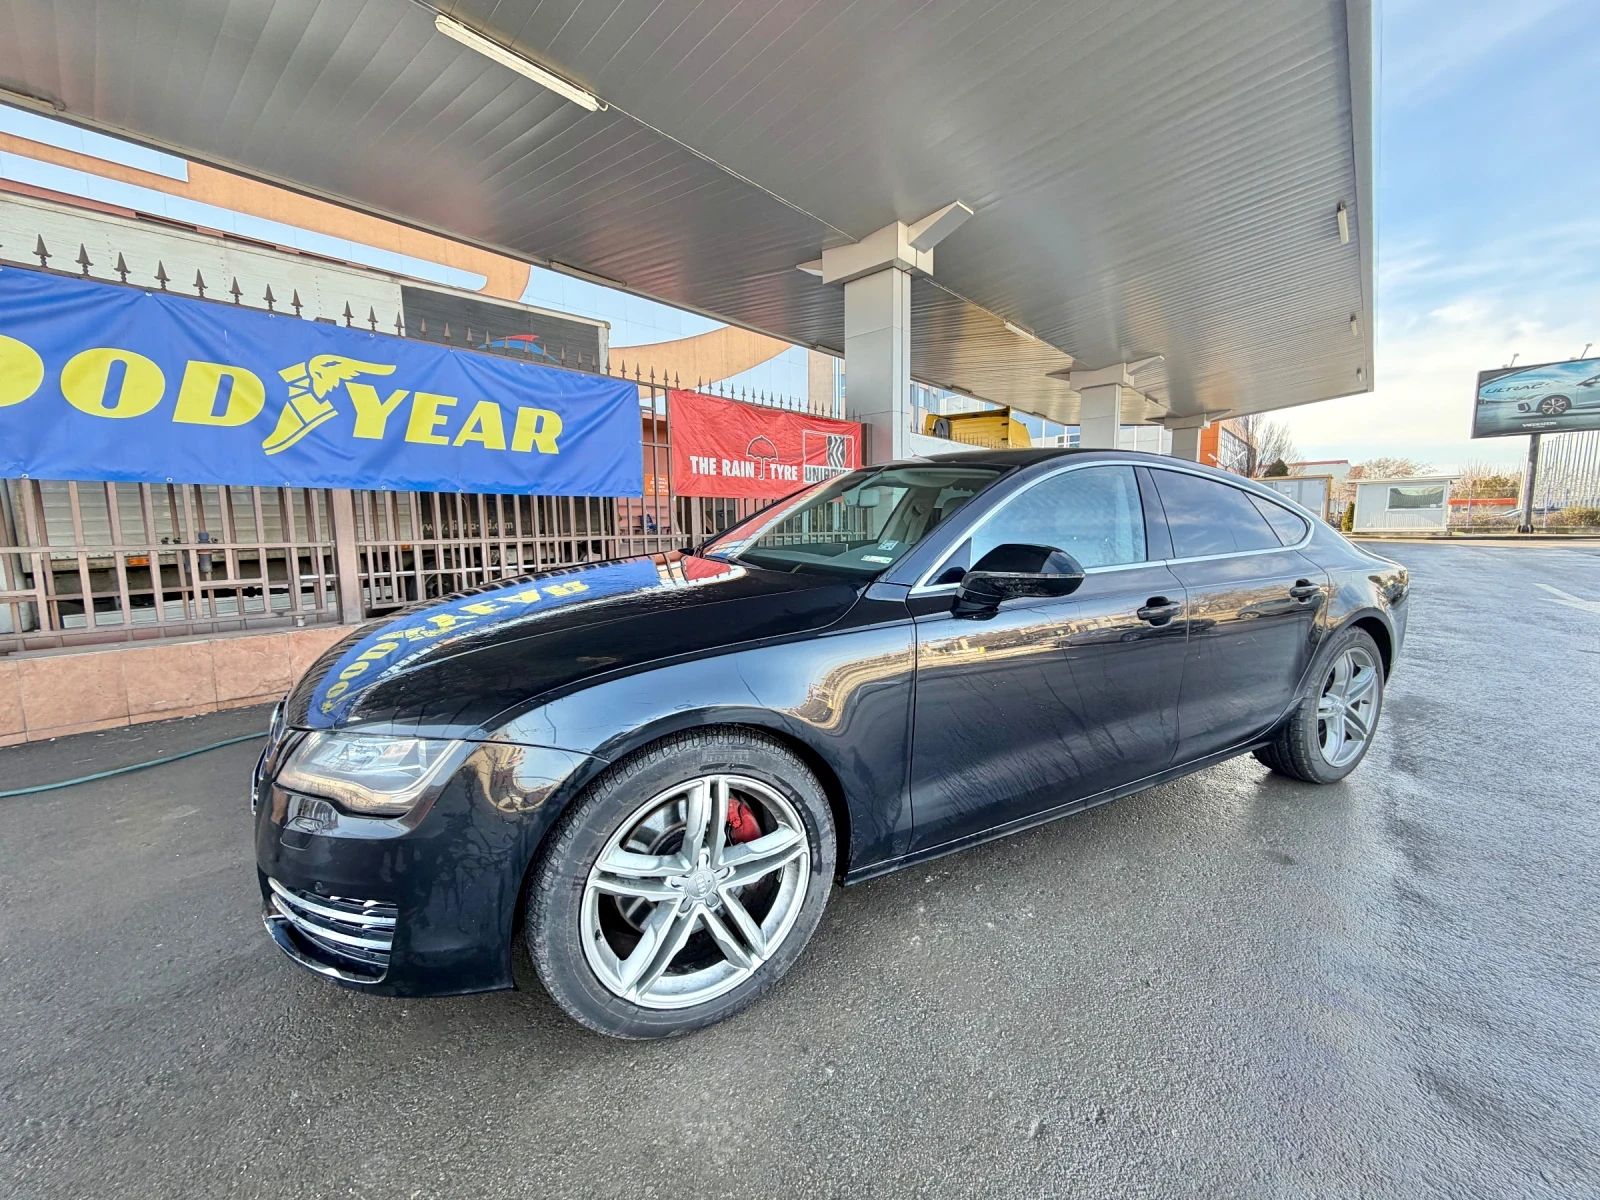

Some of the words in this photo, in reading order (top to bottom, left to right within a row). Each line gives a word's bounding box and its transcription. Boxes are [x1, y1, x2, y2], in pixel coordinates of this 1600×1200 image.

[345, 382, 563, 454] YEAR
[690, 456, 716, 475] THE
[722, 459, 754, 478] RAIN
[770, 464, 798, 481] TYRE
